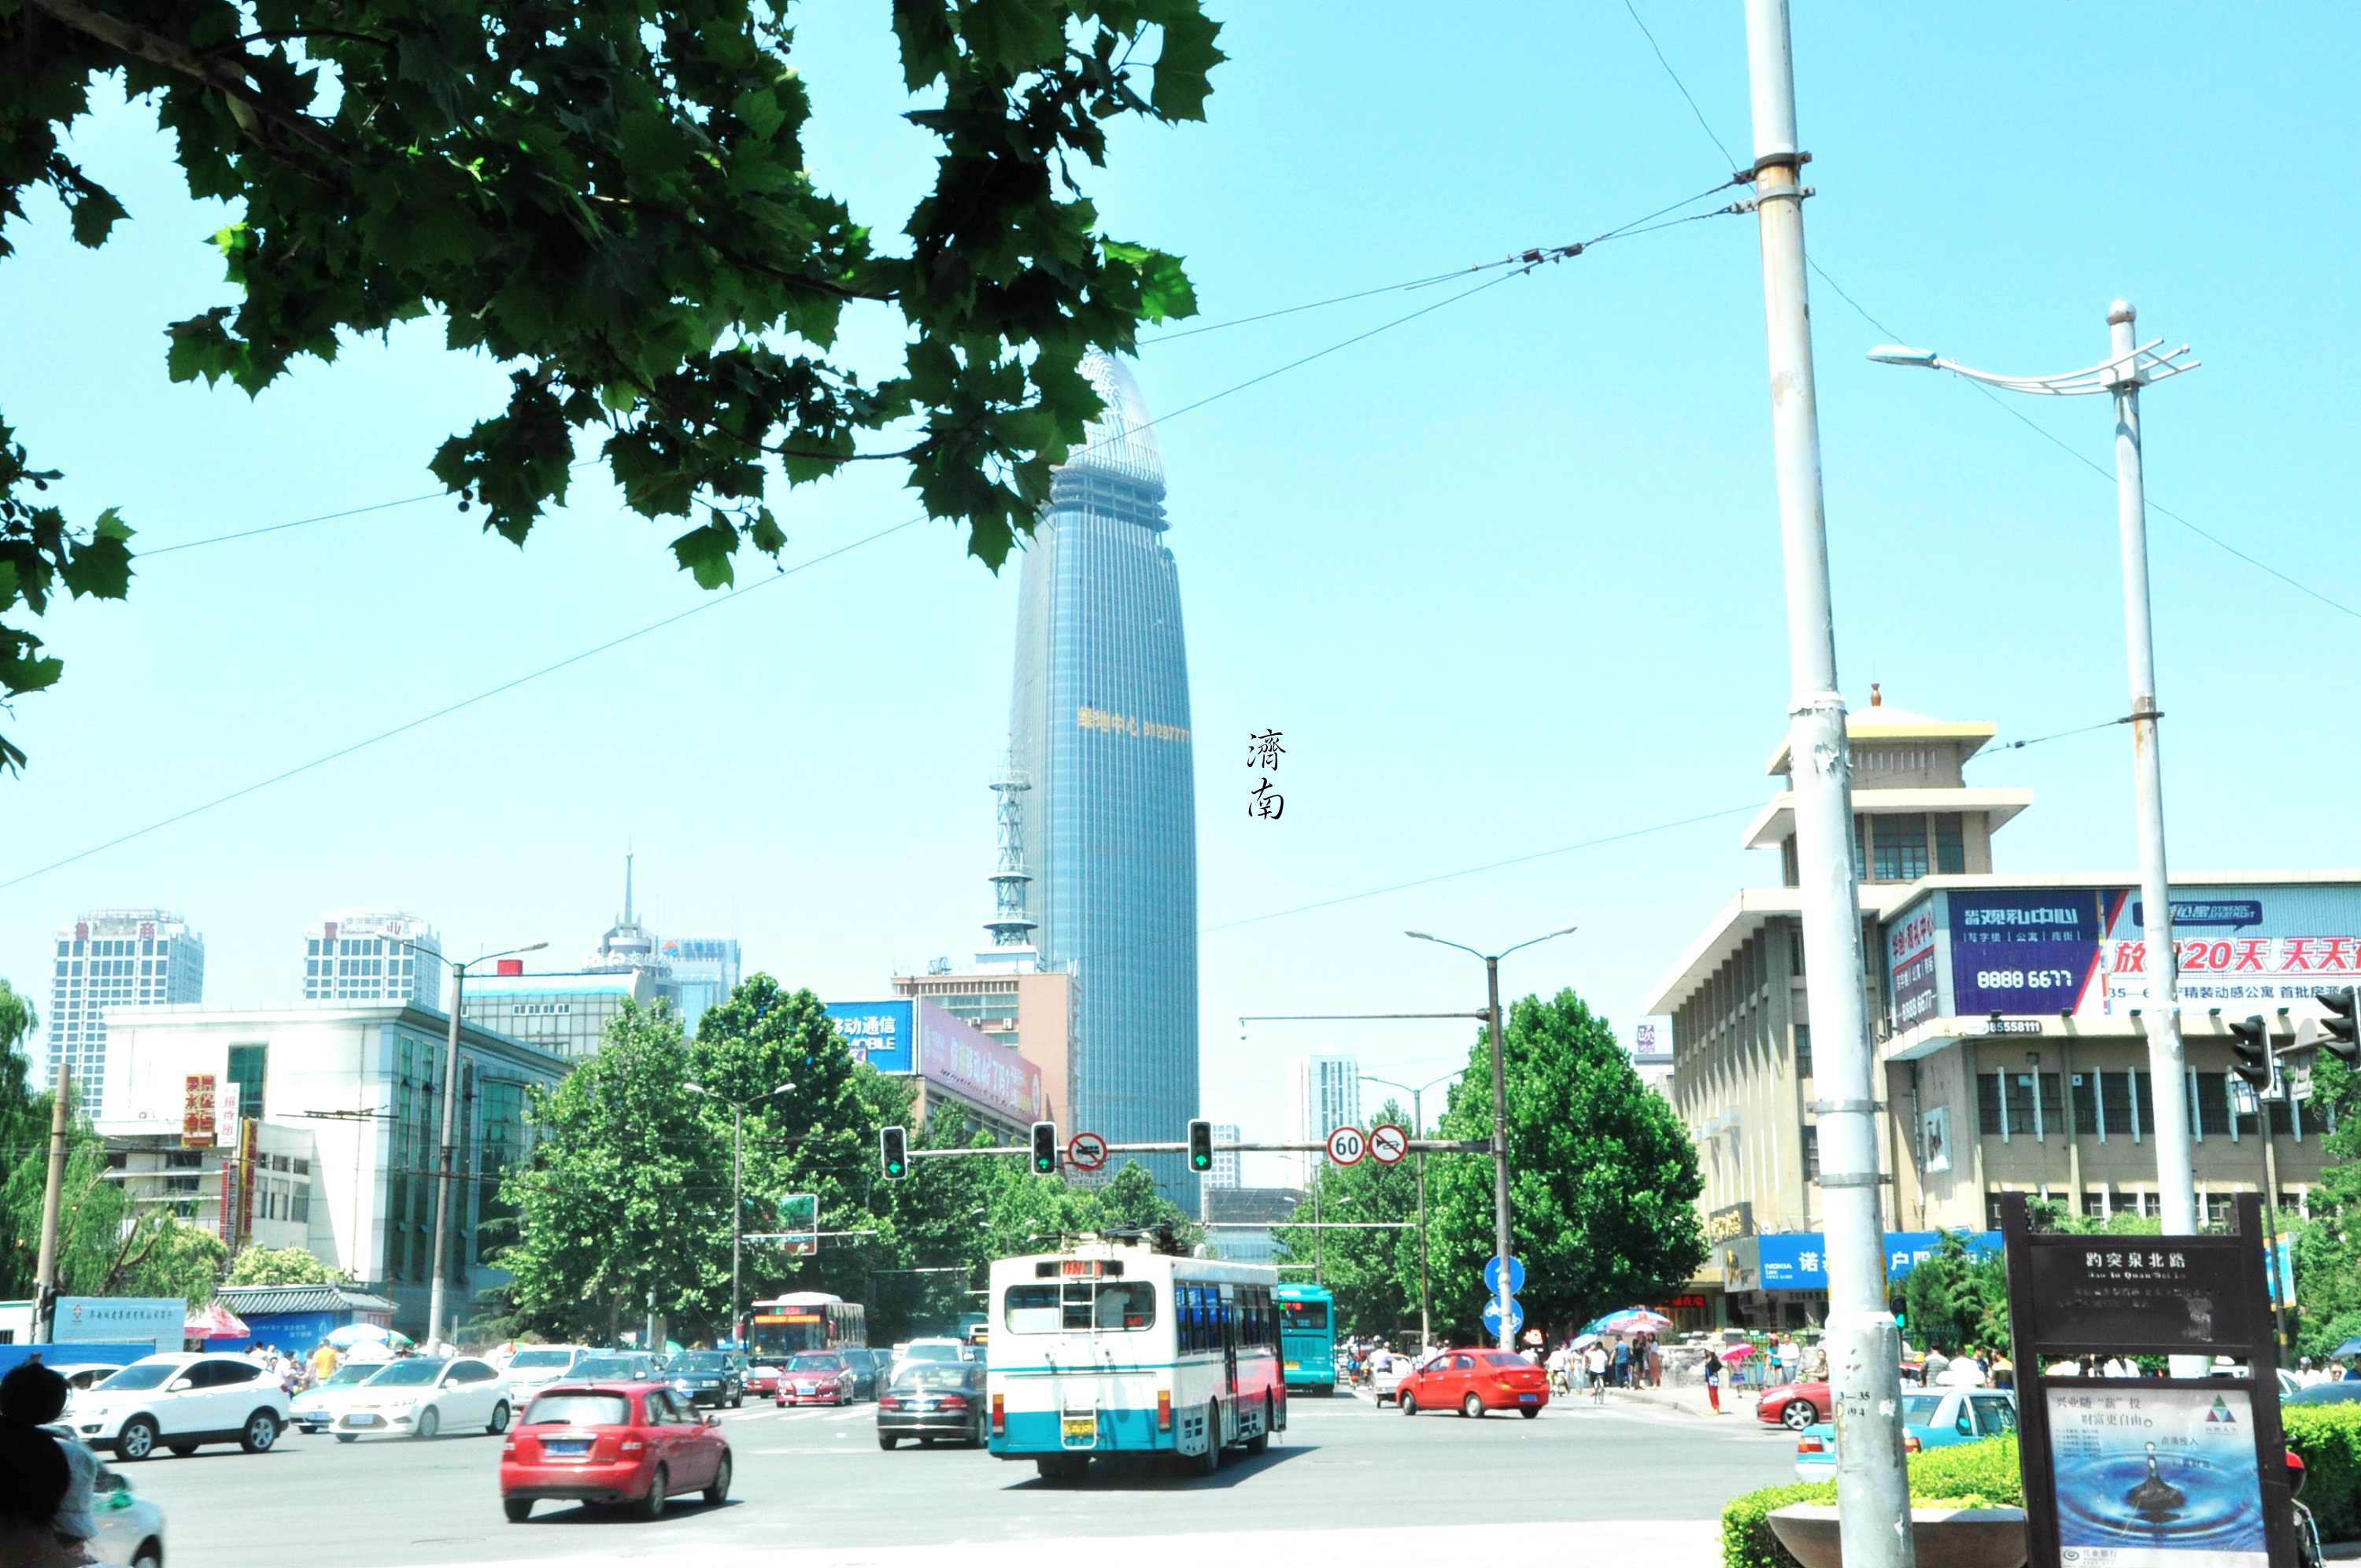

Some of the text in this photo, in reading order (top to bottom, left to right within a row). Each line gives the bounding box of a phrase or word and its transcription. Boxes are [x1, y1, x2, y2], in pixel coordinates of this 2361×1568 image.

[1977, 970, 2071, 988] 8888 6677
[1990, 1021, 2040, 1032] 85558111
[1336, 1137, 1359, 1156] 60
[2086, 1252, 2185, 1268] 趵突泉北路
